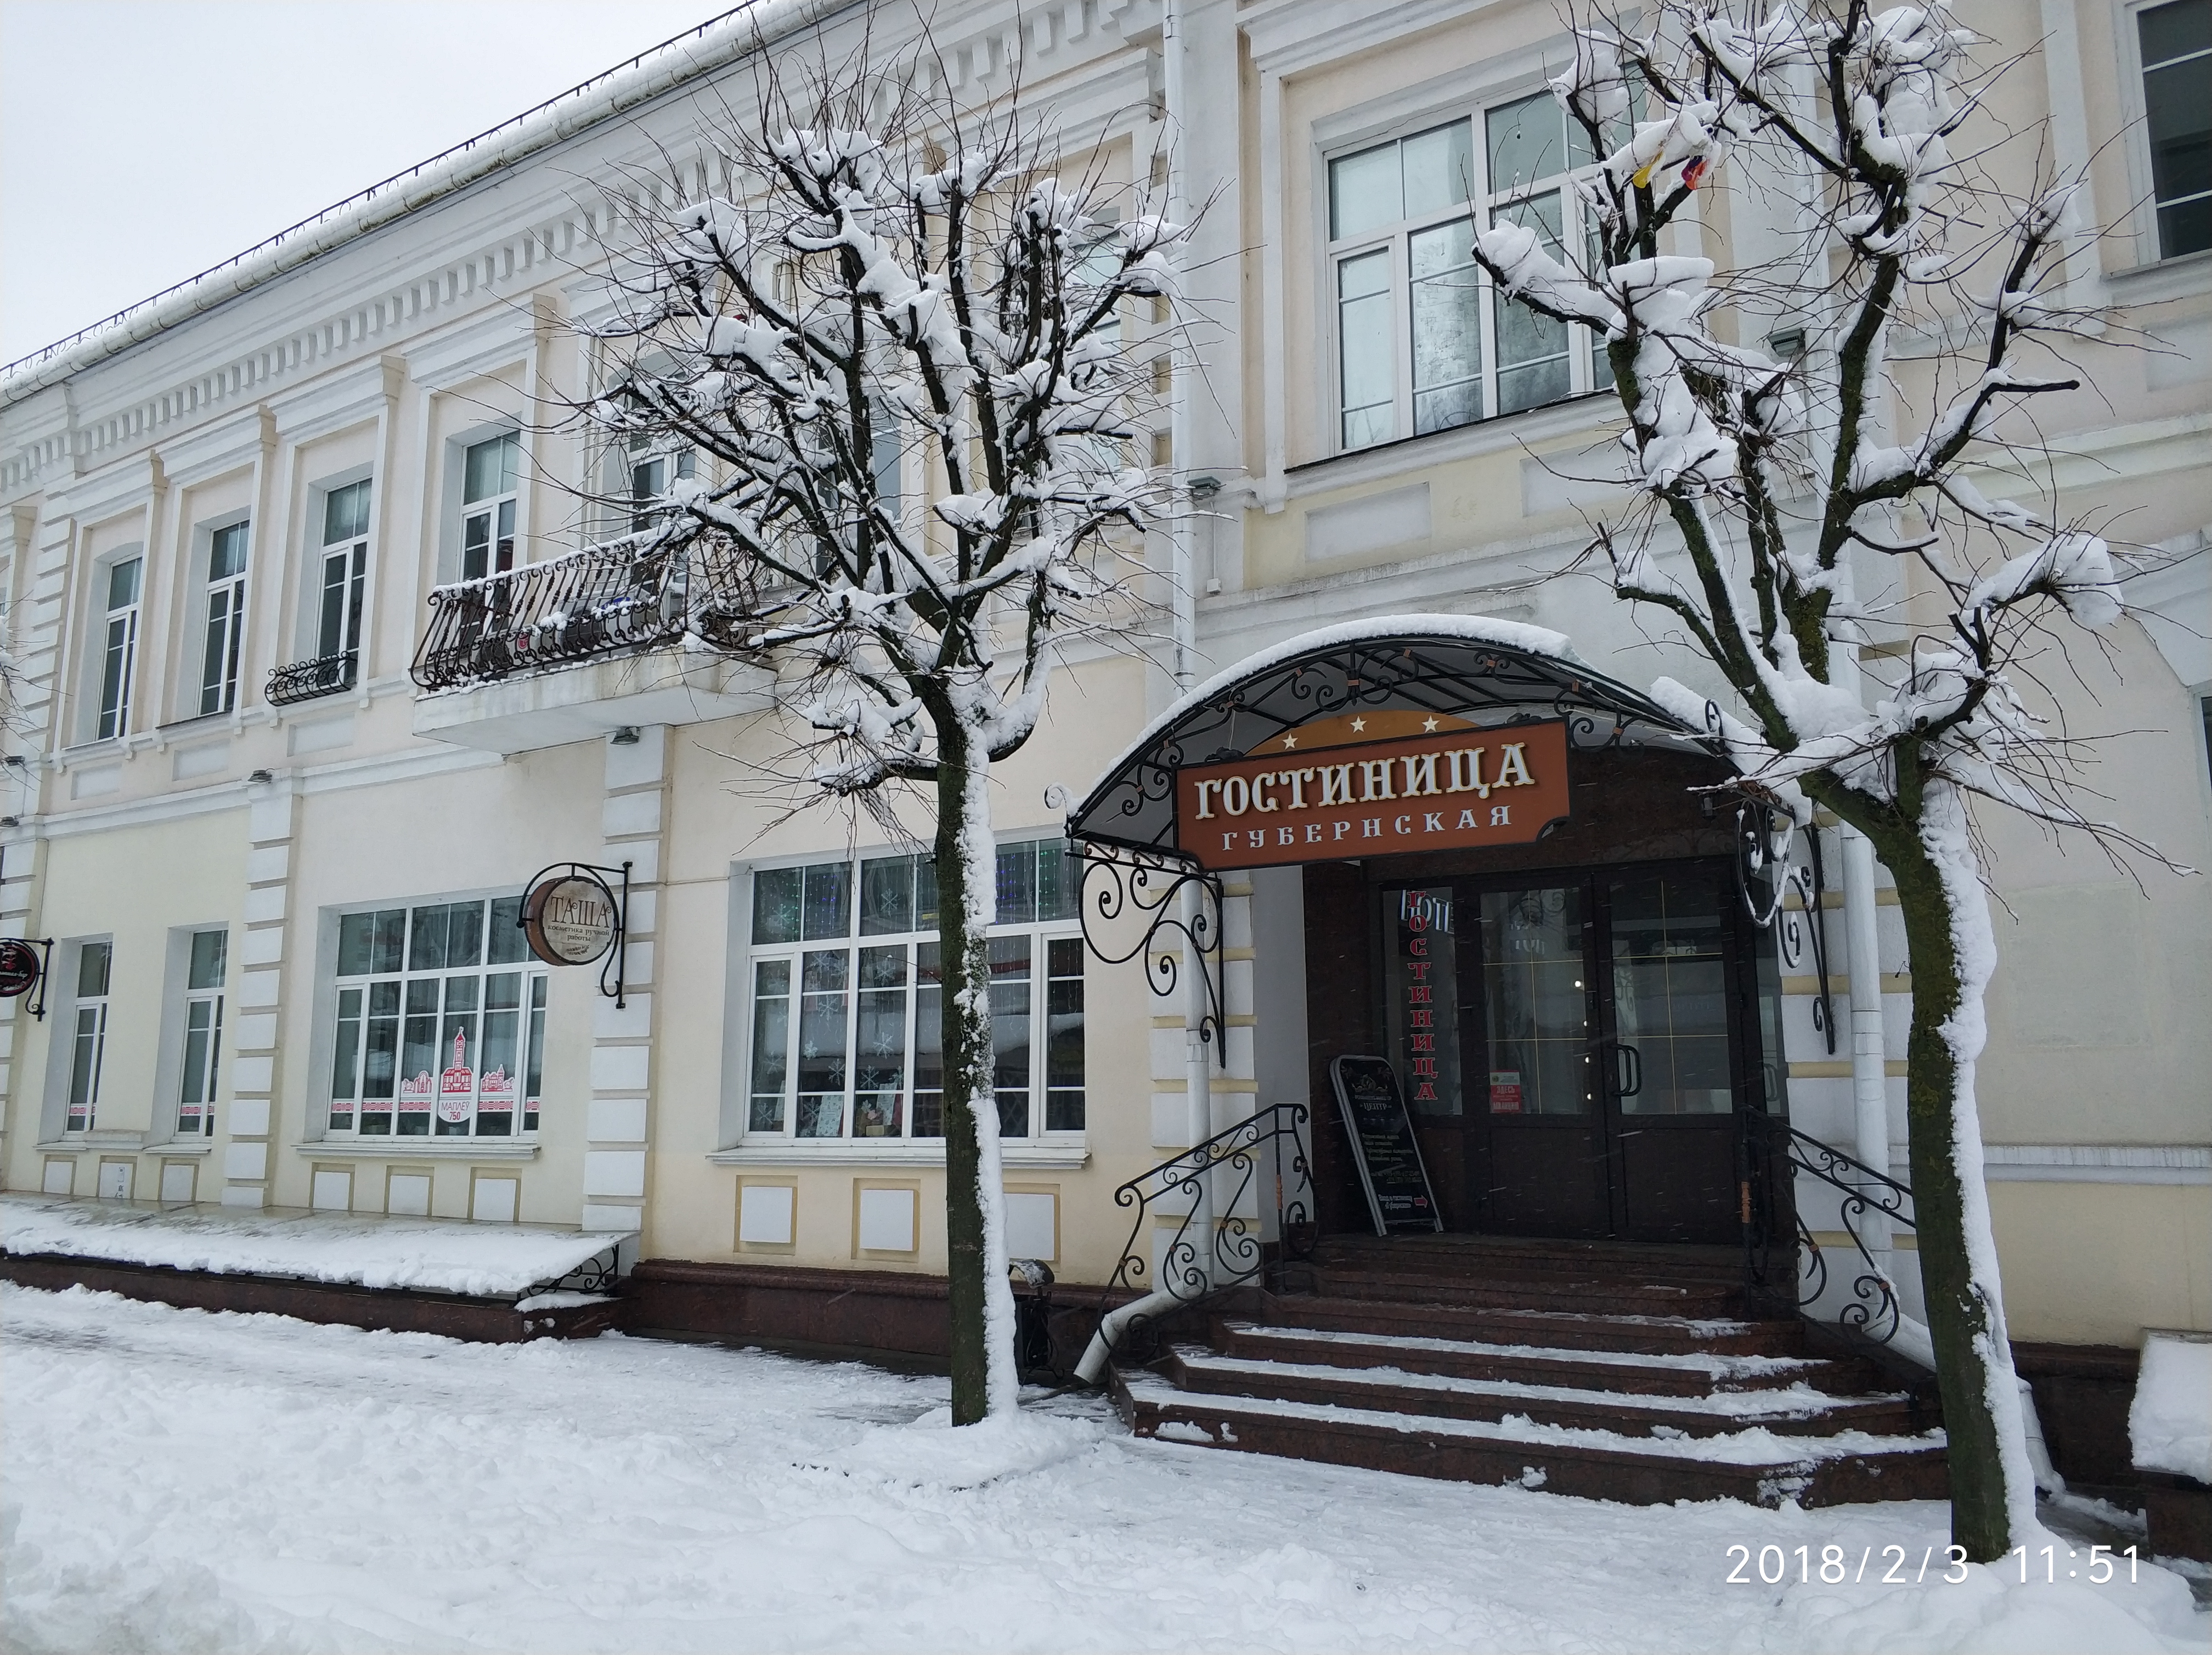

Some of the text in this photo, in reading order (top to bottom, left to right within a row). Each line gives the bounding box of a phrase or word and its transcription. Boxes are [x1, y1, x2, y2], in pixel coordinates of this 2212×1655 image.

[1194, 742, 1536, 821] ГОСТИНИЦА
[1221, 805, 1513, 851] ГУБЕРНСКАЯ
[548, 925, 583, 933] косметика
[551, 896, 612, 928] ТАША
[1407, 891, 1439, 1101] ГОСТИНИЦА
[449, 1111, 461, 1121] 750
